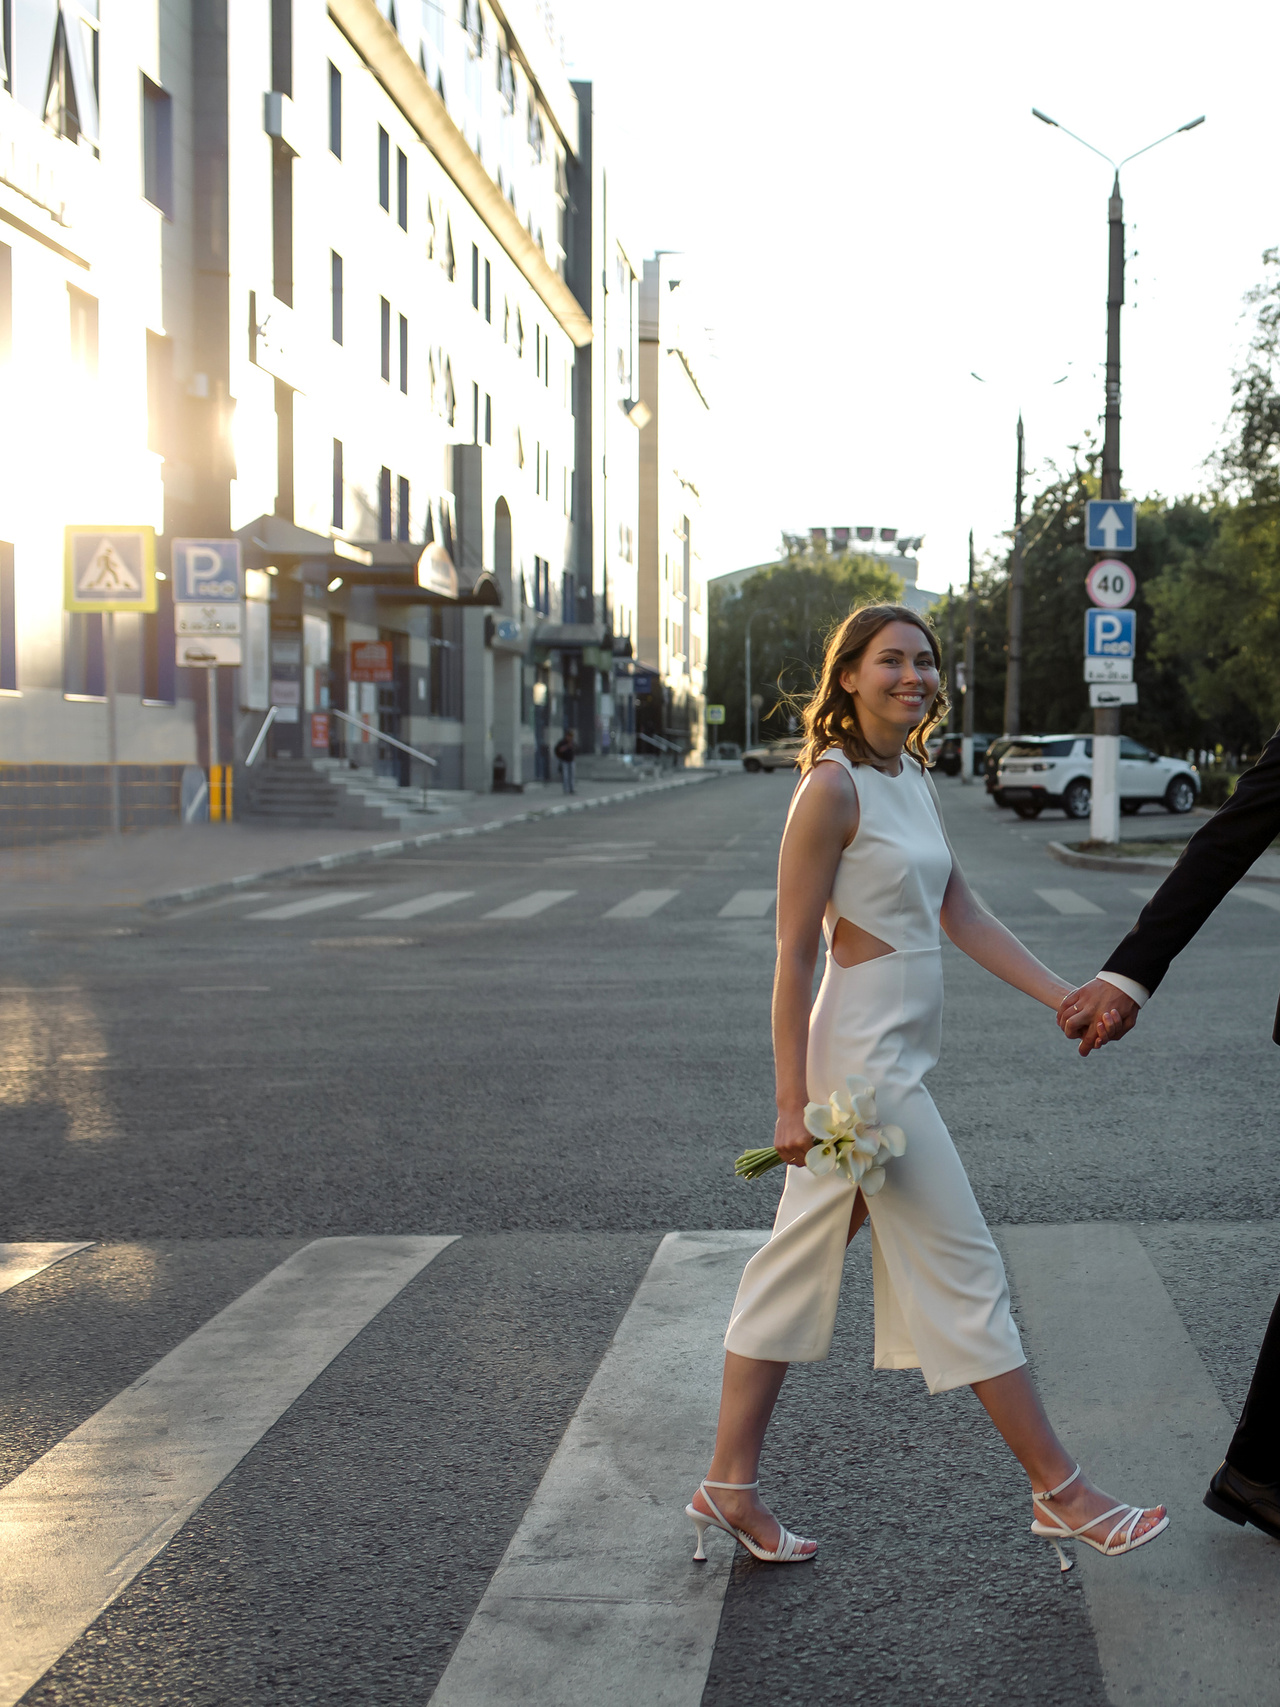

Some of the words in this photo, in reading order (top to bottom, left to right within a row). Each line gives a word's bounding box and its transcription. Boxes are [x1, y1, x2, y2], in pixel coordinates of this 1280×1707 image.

[186, 546, 222, 594] P
[1097, 575, 1124, 594] 40
[1095, 614, 1122, 654] P
